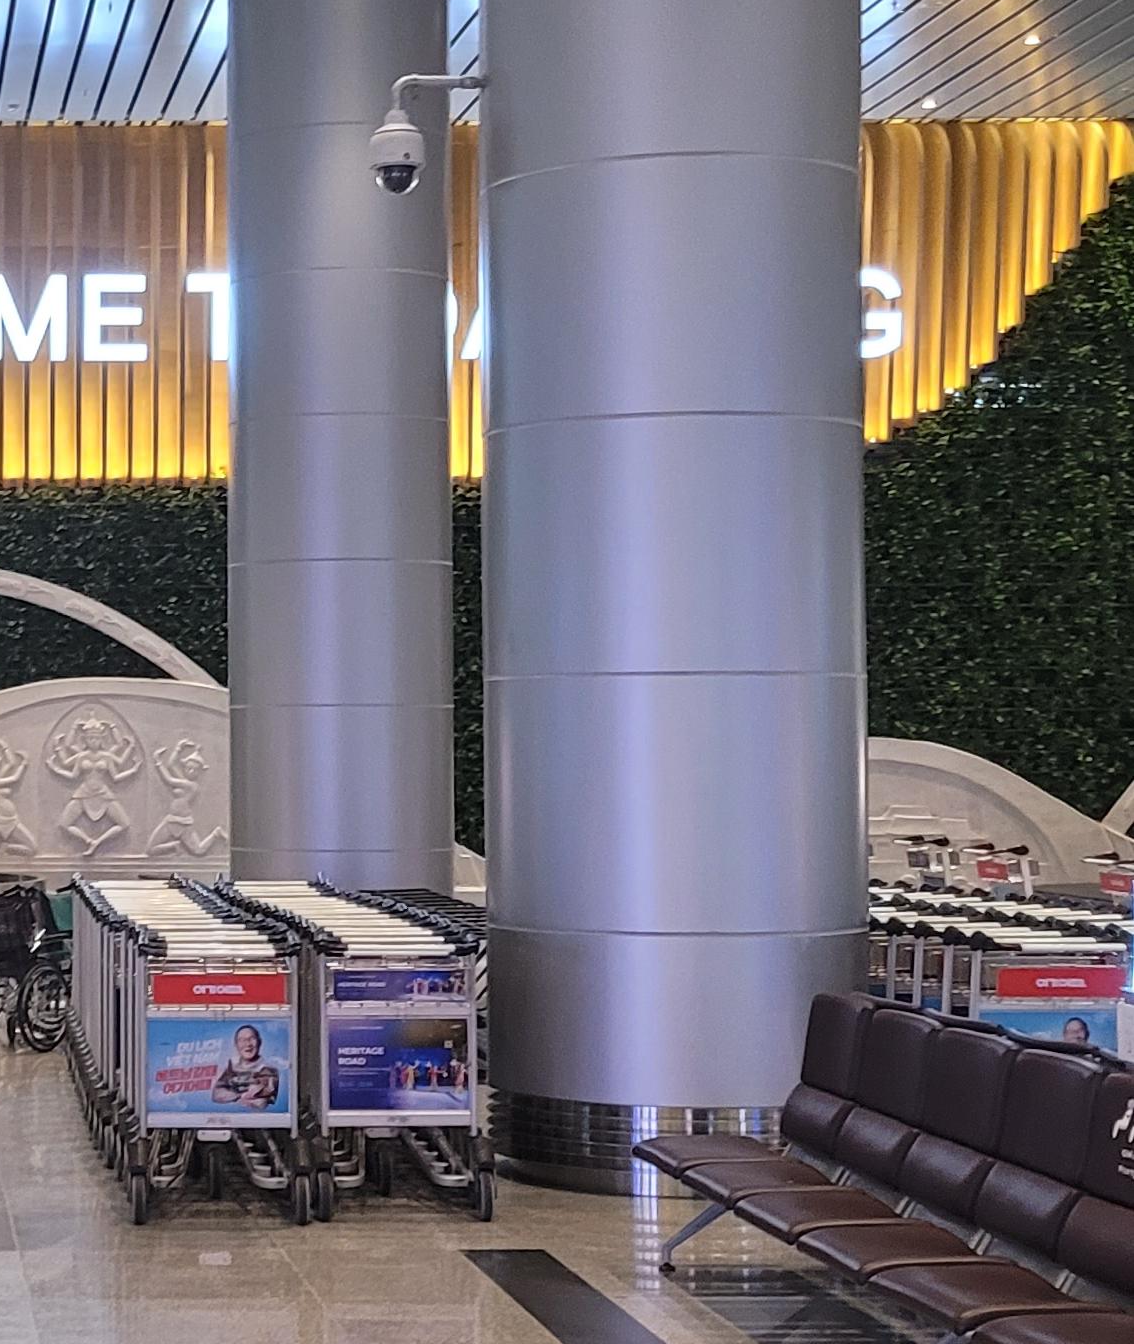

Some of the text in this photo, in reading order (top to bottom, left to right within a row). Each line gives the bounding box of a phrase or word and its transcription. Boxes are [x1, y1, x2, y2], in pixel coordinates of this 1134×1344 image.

[186, 272, 230, 361] T
[337, 1046, 385, 1056] HERITAGE
[337, 1057, 367, 1066] ROAD
